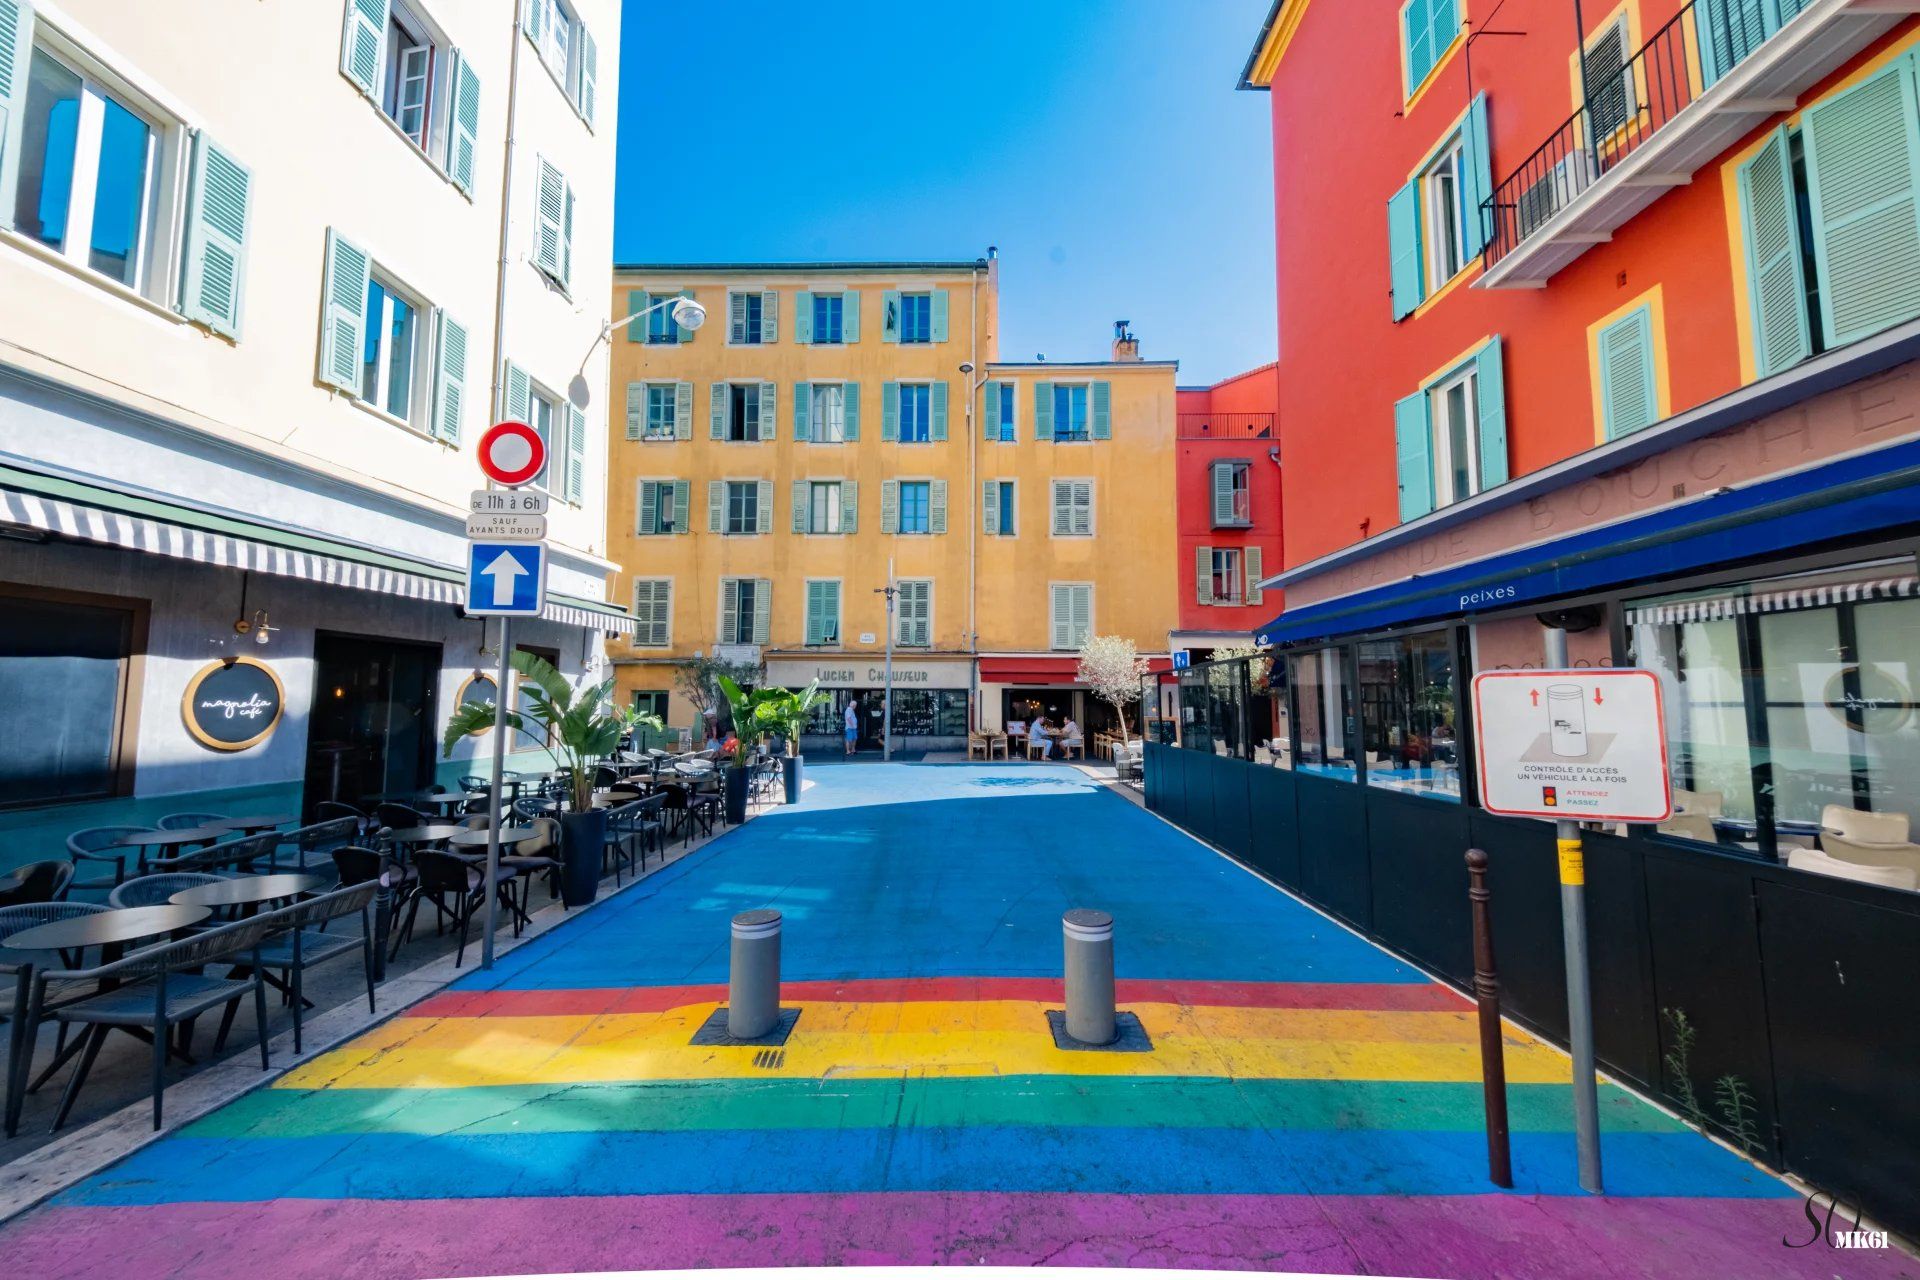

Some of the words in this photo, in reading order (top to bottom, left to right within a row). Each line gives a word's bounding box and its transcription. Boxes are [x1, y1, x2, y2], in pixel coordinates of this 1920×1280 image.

[472, 501, 483, 509] DE
[487, 495, 504, 509] 11h
[510, 495, 516, 509] à
[523, 496, 540, 510] 6h
[492, 517, 518, 525] SAUF
[469, 526, 506, 534] AYANTS
[510, 527, 540, 535] DROIT
[1460, 585, 1516, 610] peixes
[817, 667, 855, 682] LUCIEN
[202, 692, 272, 719] magnolia
[1524, 765, 1573, 773] CONTRÔLE
[1532, 773, 1578, 781] VÉHICULE
